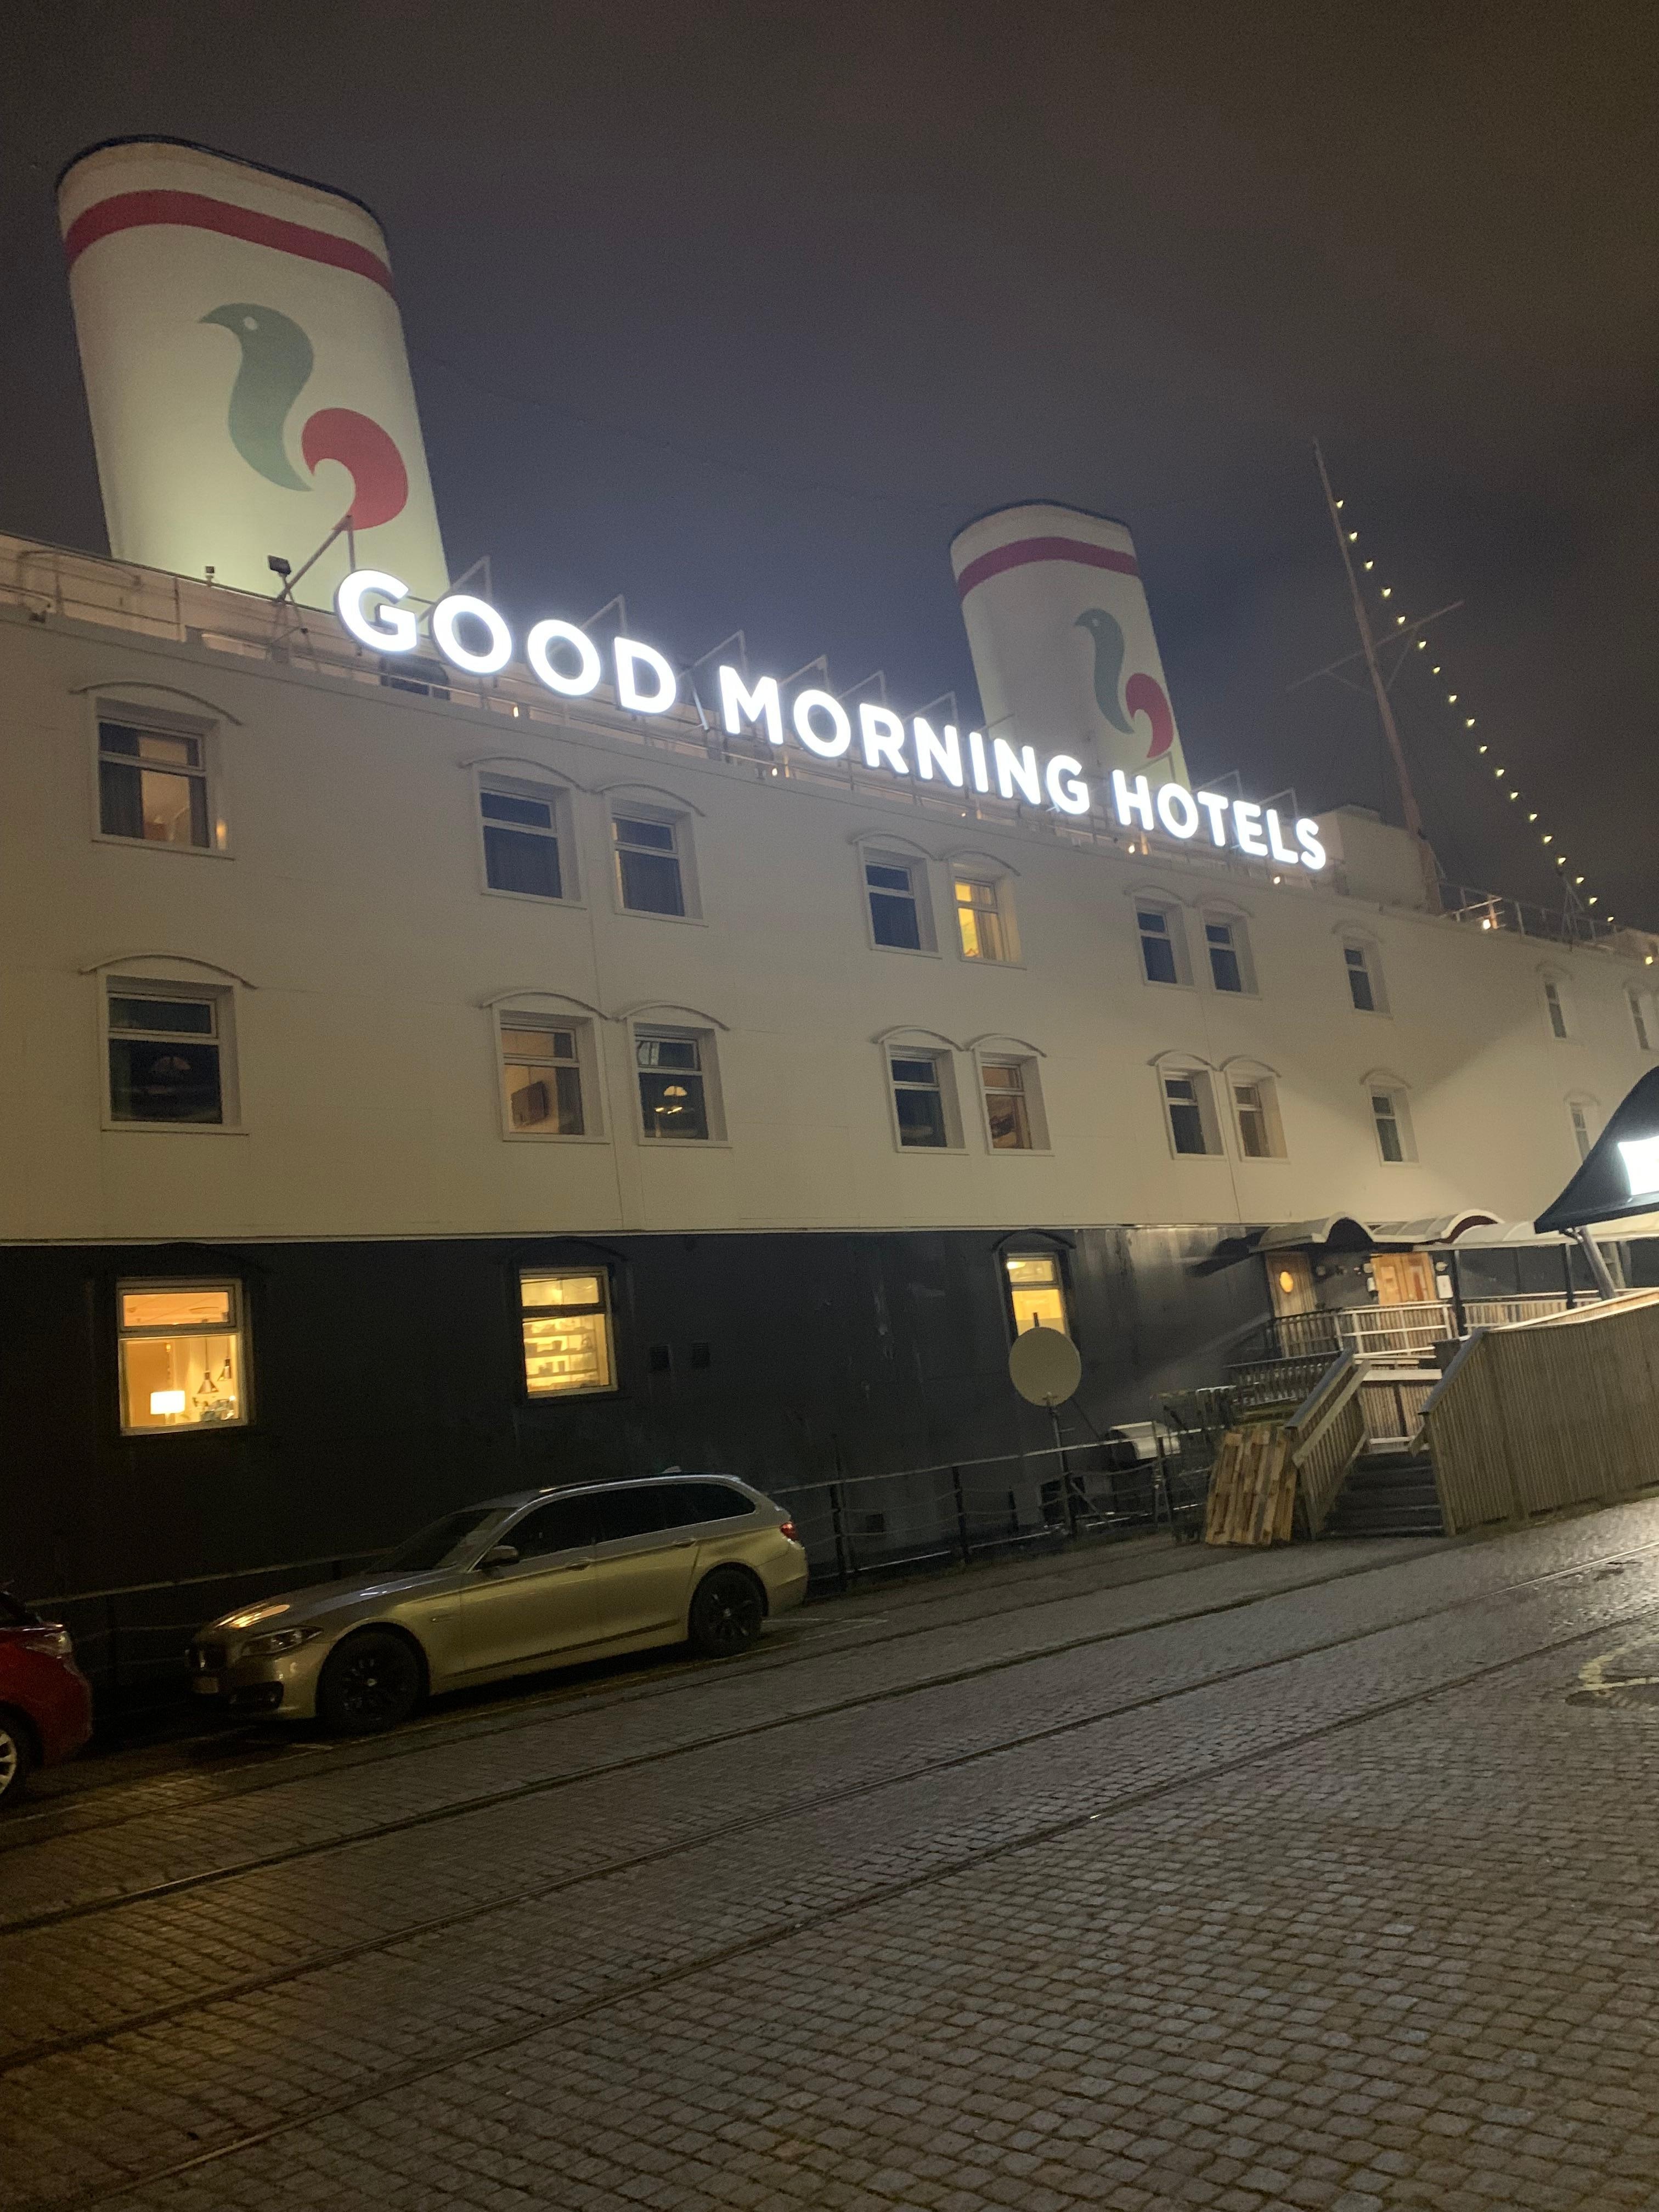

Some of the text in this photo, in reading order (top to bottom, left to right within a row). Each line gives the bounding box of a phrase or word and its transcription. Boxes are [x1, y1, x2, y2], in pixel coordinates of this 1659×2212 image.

[337, 569, 1327, 870] GOOD MORNING HOTELS
